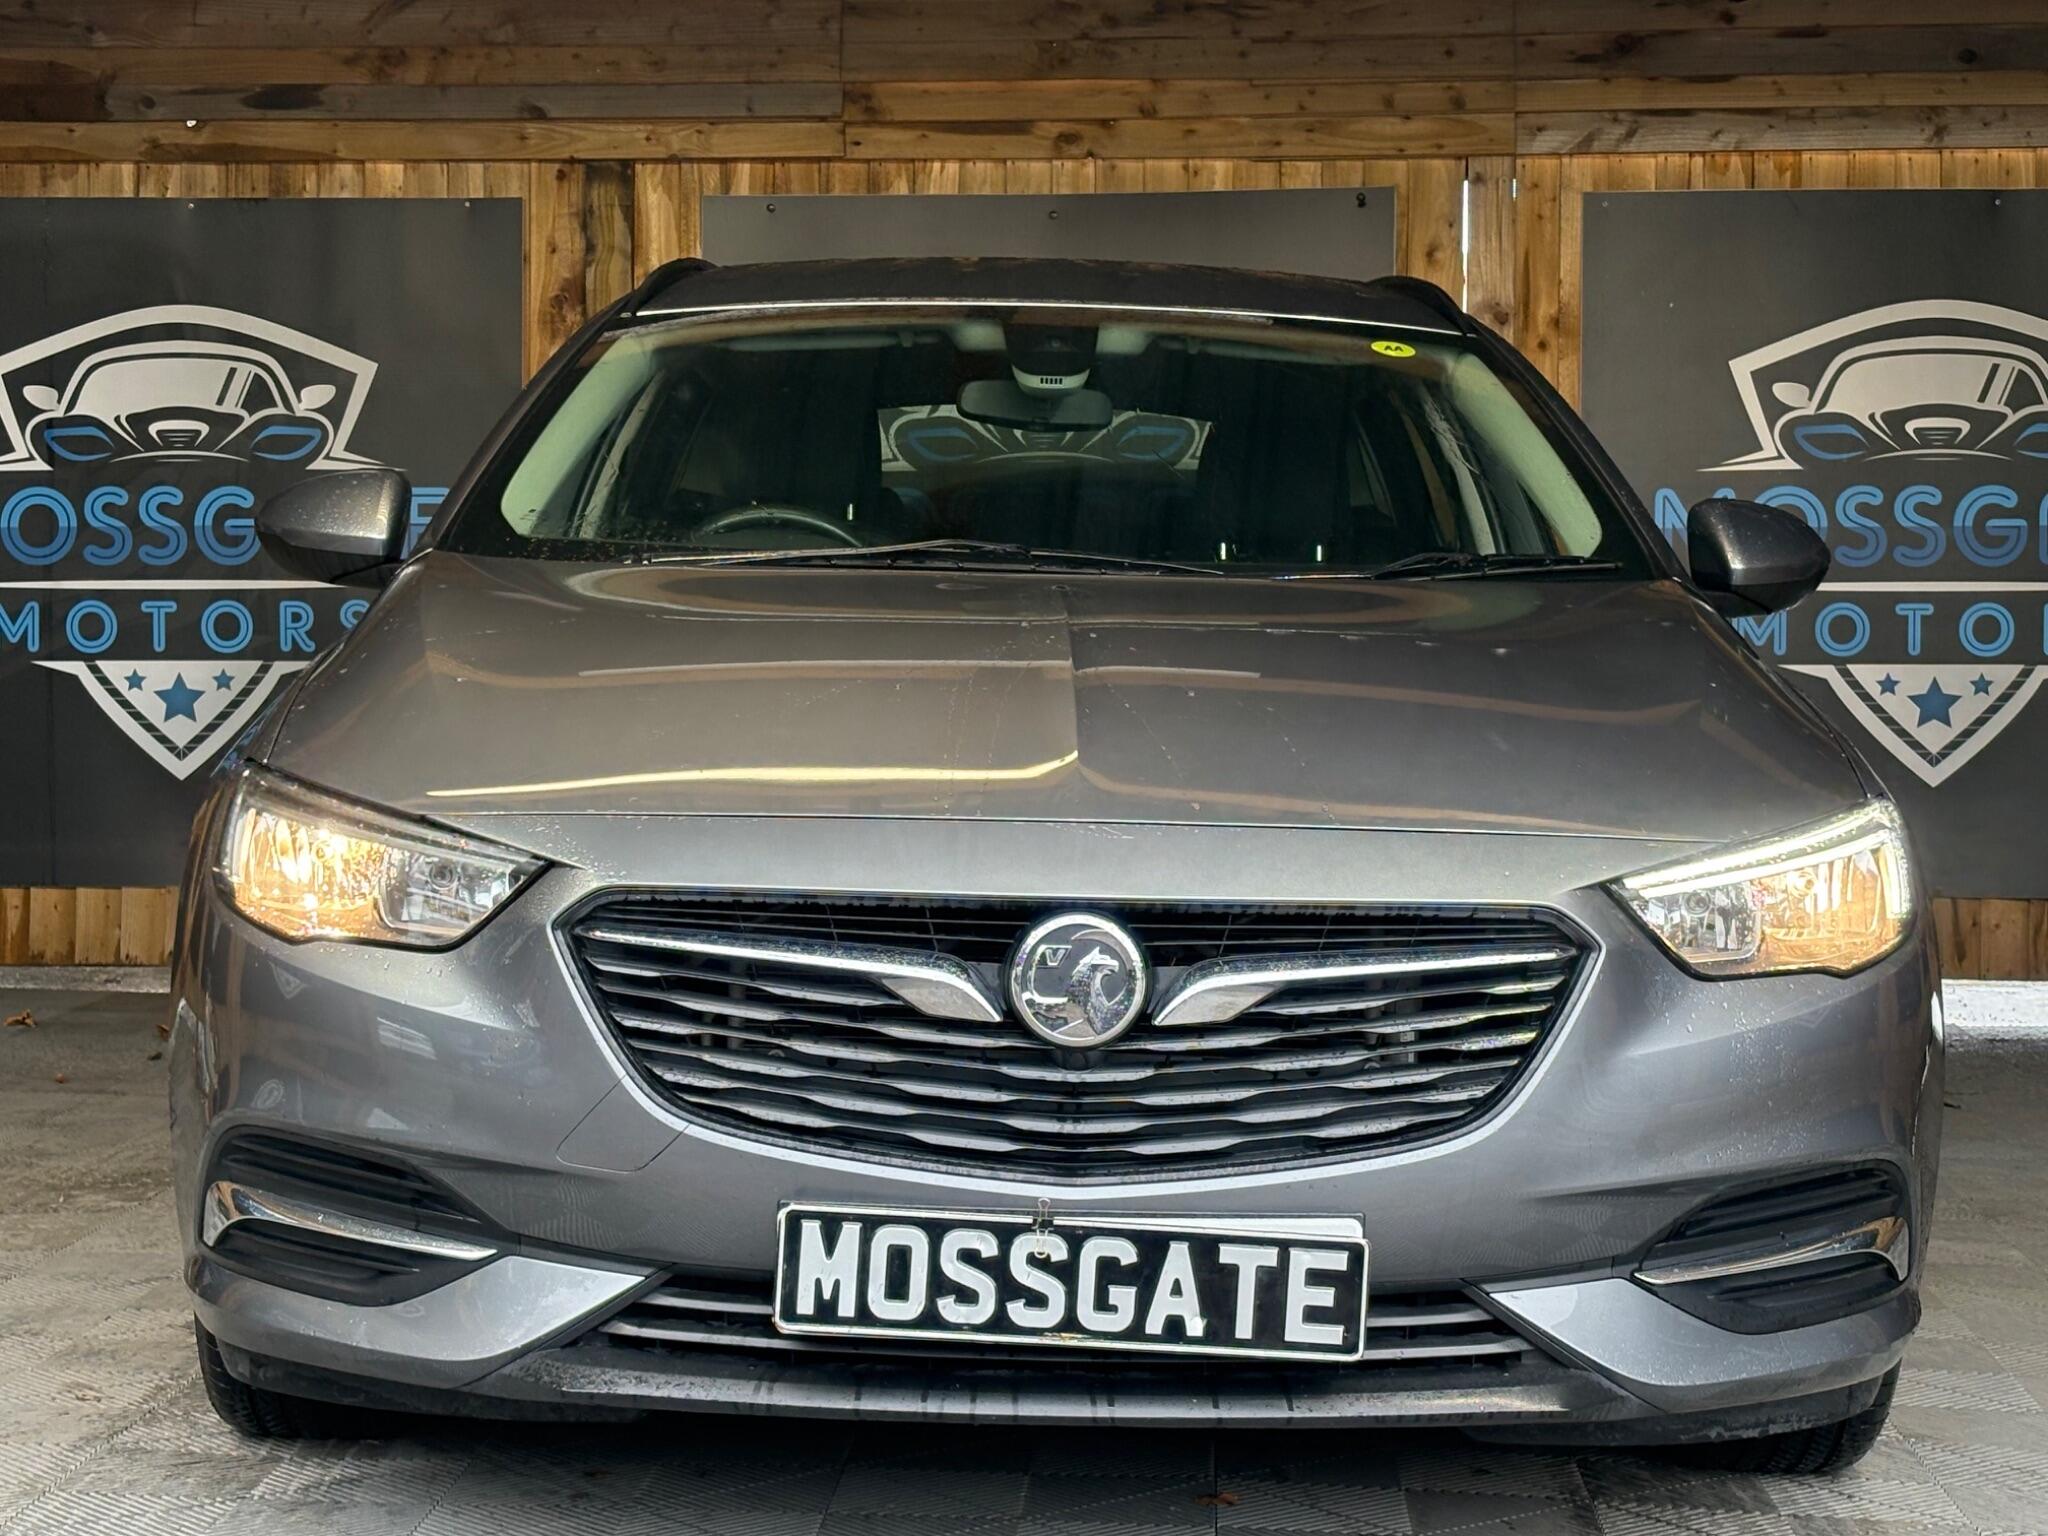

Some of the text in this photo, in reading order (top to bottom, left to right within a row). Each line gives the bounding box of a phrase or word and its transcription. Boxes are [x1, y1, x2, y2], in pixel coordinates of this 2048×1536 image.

[0, 485, 450, 566] OSSG
[1655, 485, 2048, 567] OSSG
[1731, 602, 2048, 657] MOTO
[796, 1219, 1350, 1346] MOSSGATE
